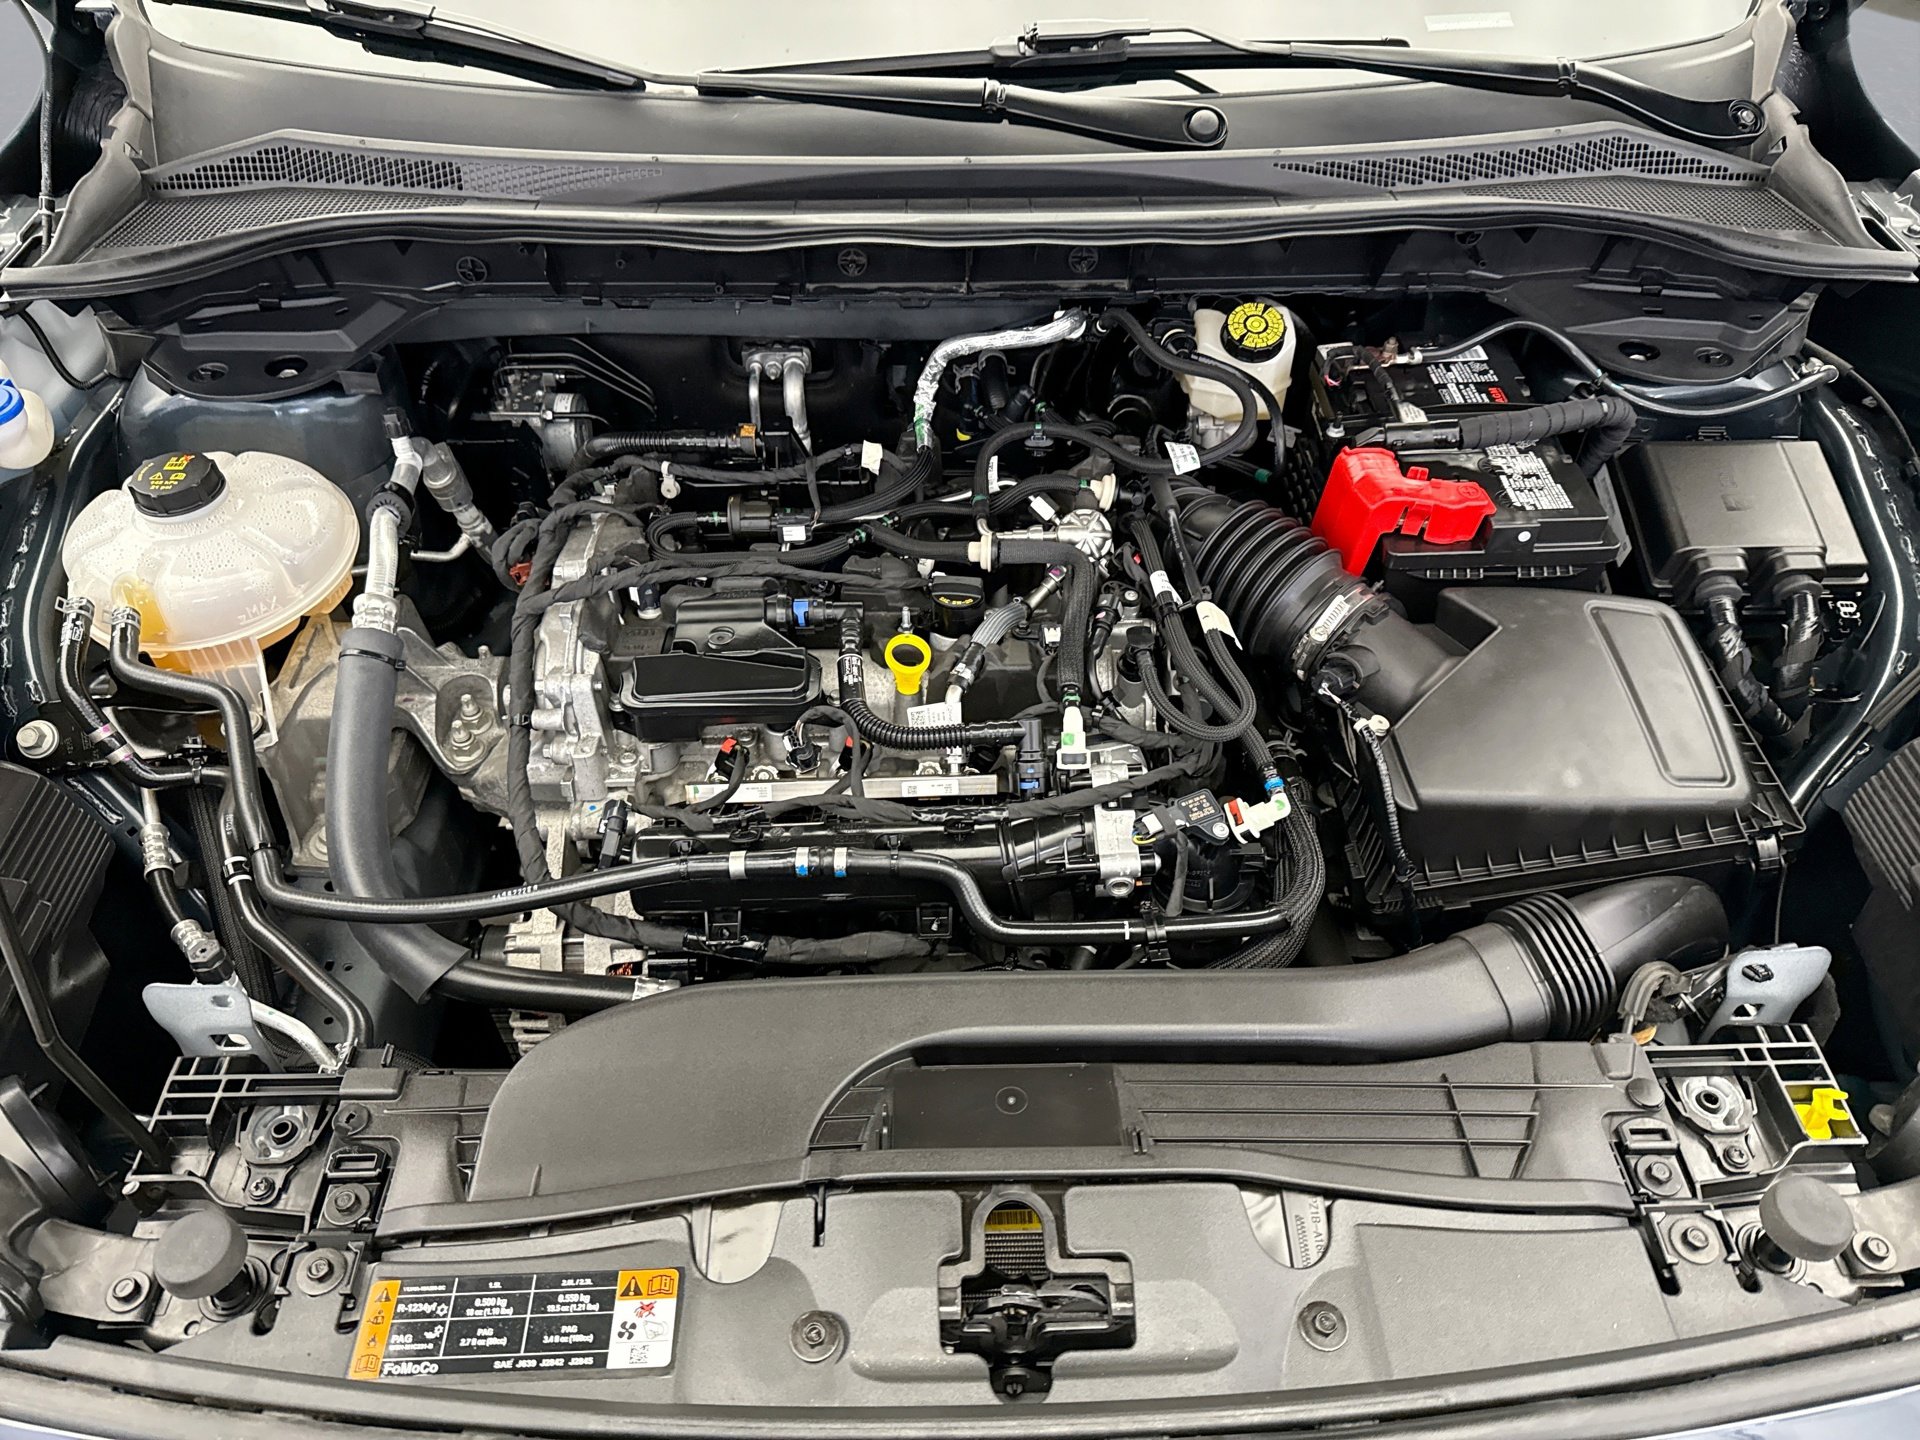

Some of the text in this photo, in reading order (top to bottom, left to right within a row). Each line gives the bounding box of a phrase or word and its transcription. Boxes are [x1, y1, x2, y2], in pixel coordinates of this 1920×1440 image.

[1487, 387, 1505, 403] AGM
[496, 1297, 508, 1308] kg
[579, 1293, 591, 1304] kg
[396, 1302, 438, 1314] R-1234yf
[476, 1327, 494, 1337] PAG
[560, 1324, 578, 1334] PAG
[390, 1333, 413, 1344] PAG
[382, 1361, 439, 1375] FoMoCo
[493, 1359, 513, 1369] SAE
